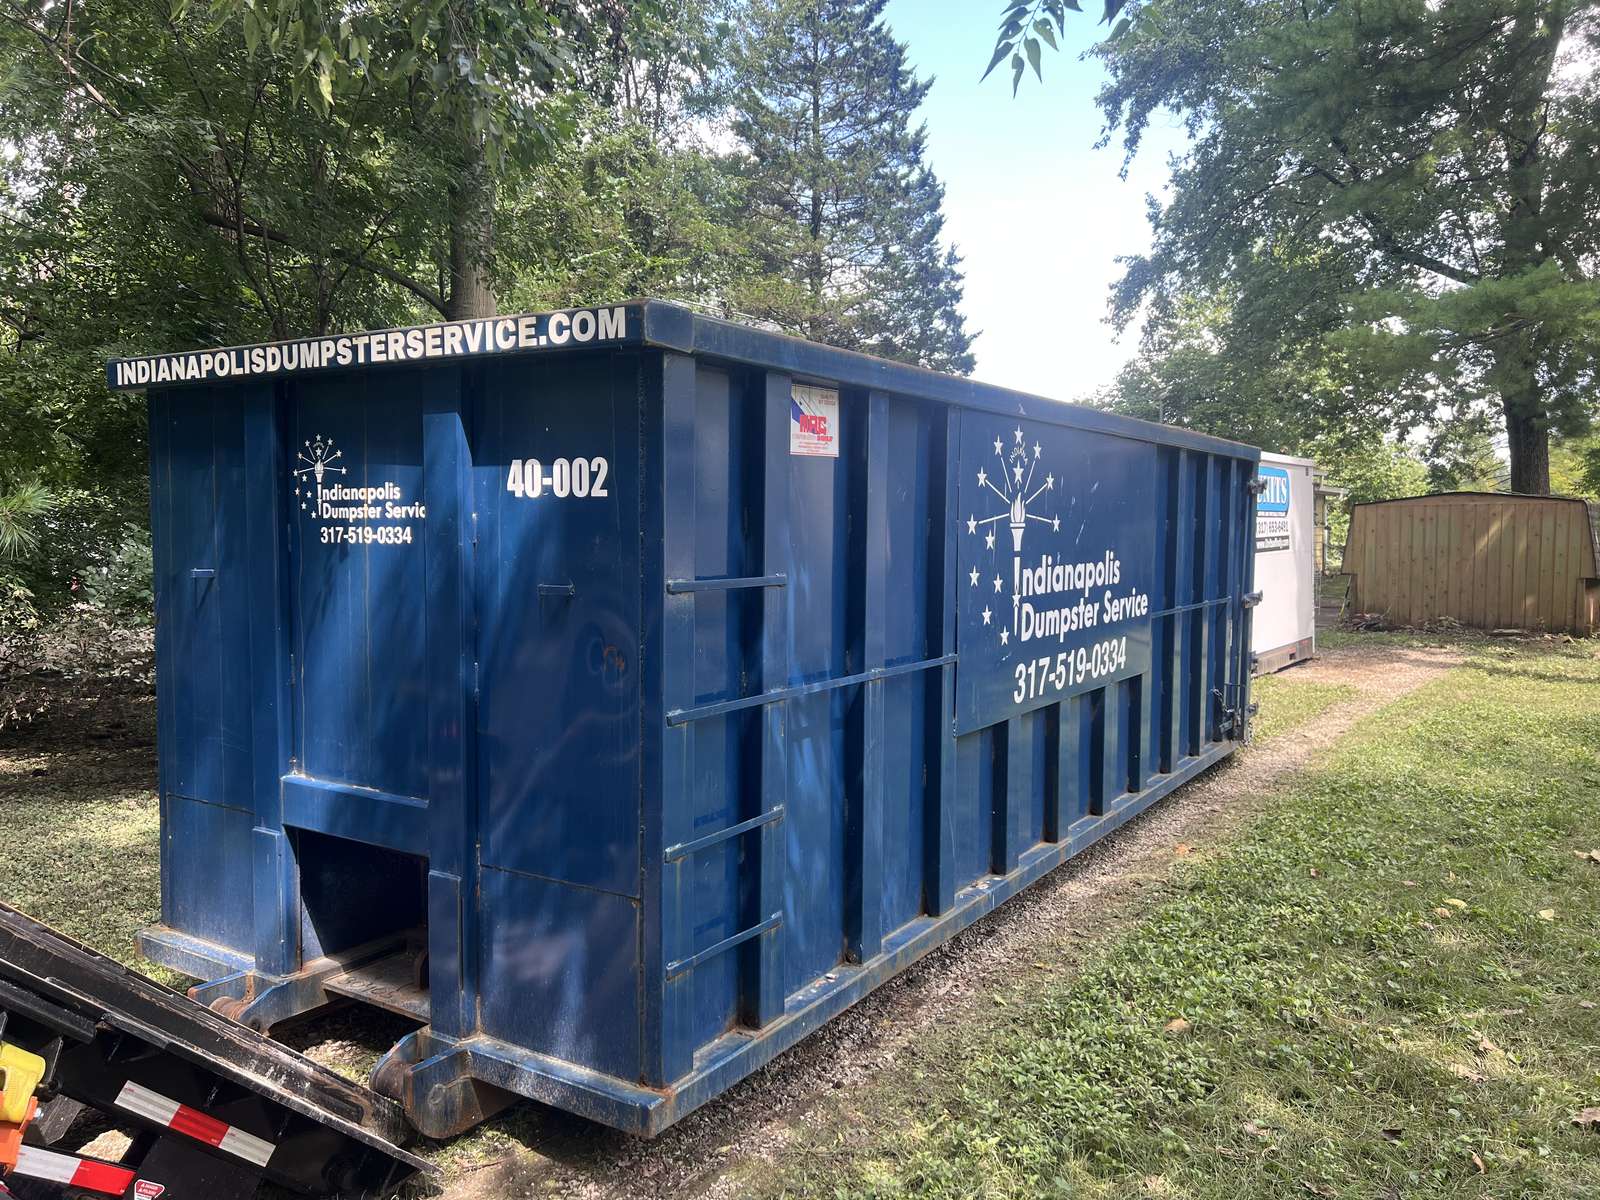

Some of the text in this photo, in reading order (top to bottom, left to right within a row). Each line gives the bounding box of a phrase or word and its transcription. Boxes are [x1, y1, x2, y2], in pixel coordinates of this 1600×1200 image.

[116, 306, 627, 386] INDIANAPOLISDUMPSTERSERVICE.COM
[317, 482, 401, 504] Indianapolis
[506, 456, 609, 498] 40-002
[322, 502, 426, 522] Dumpster Servic
[320, 526, 412, 544] 317-519-0334
[1014, 550, 1121, 598] Indianapolis
[1021, 587, 1149, 643] Dumpster Service
[1013, 636, 1127, 704] 317-519-0334
